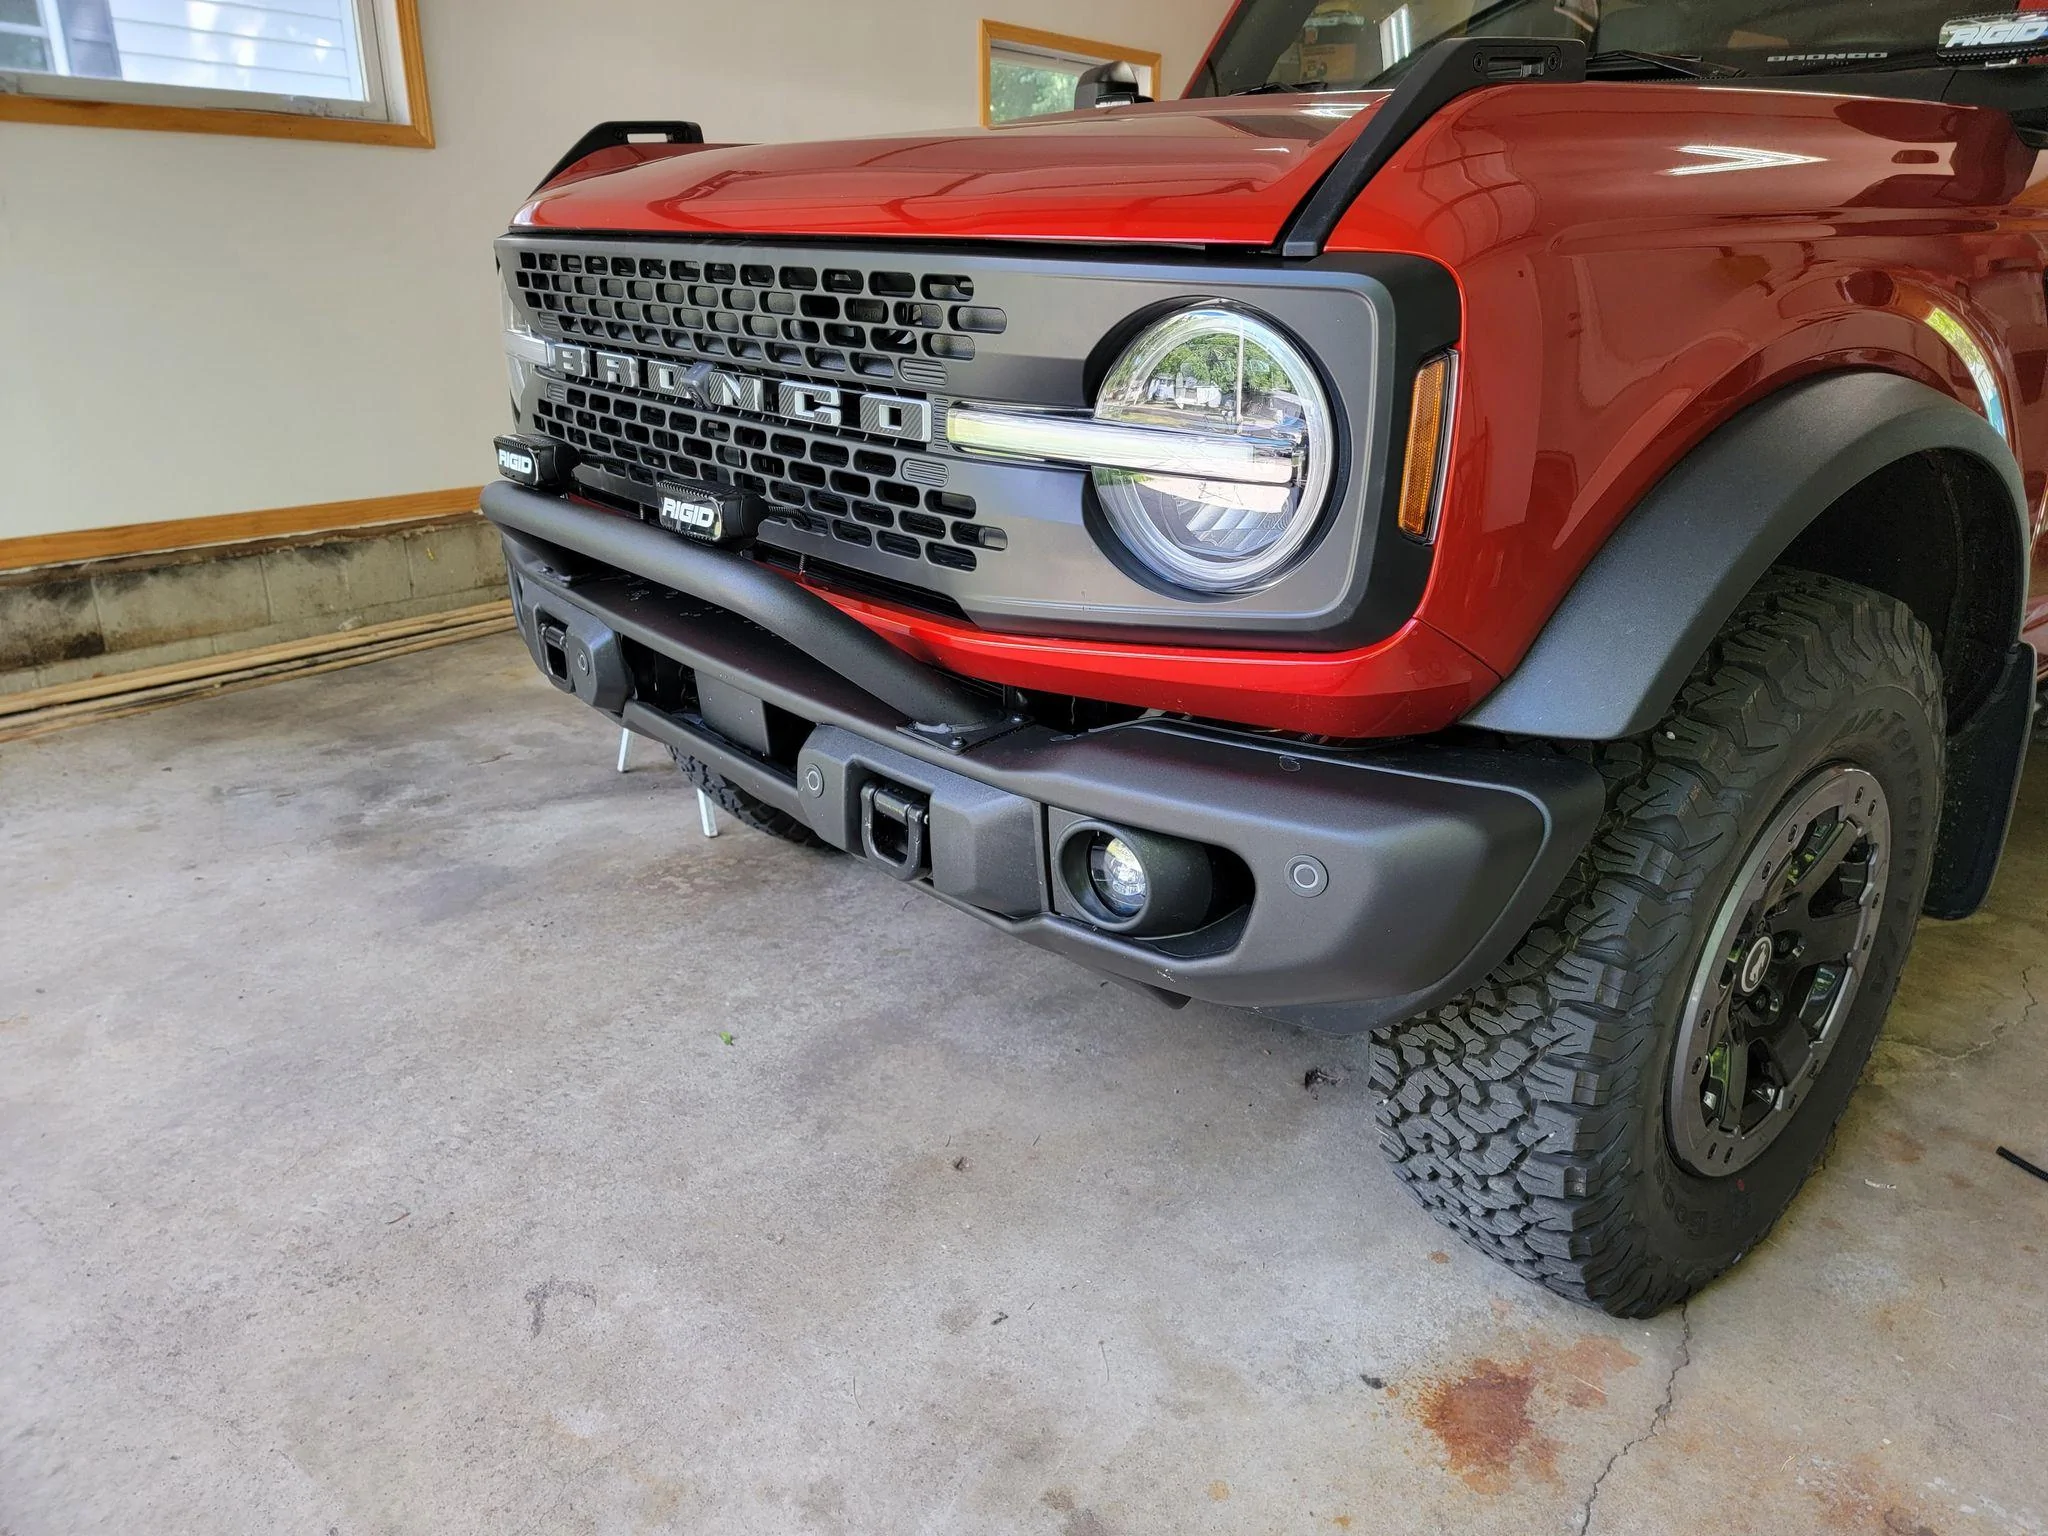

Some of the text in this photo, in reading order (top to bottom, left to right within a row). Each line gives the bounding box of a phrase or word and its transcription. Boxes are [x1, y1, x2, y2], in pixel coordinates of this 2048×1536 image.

[1945, 22, 2048, 48] RIGID
[1767, 52, 1888, 62] BRONCO
[554, 342, 932, 443] BRONCO
[498, 448, 533, 474] RIGID
[662, 497, 715, 528] RIGID
